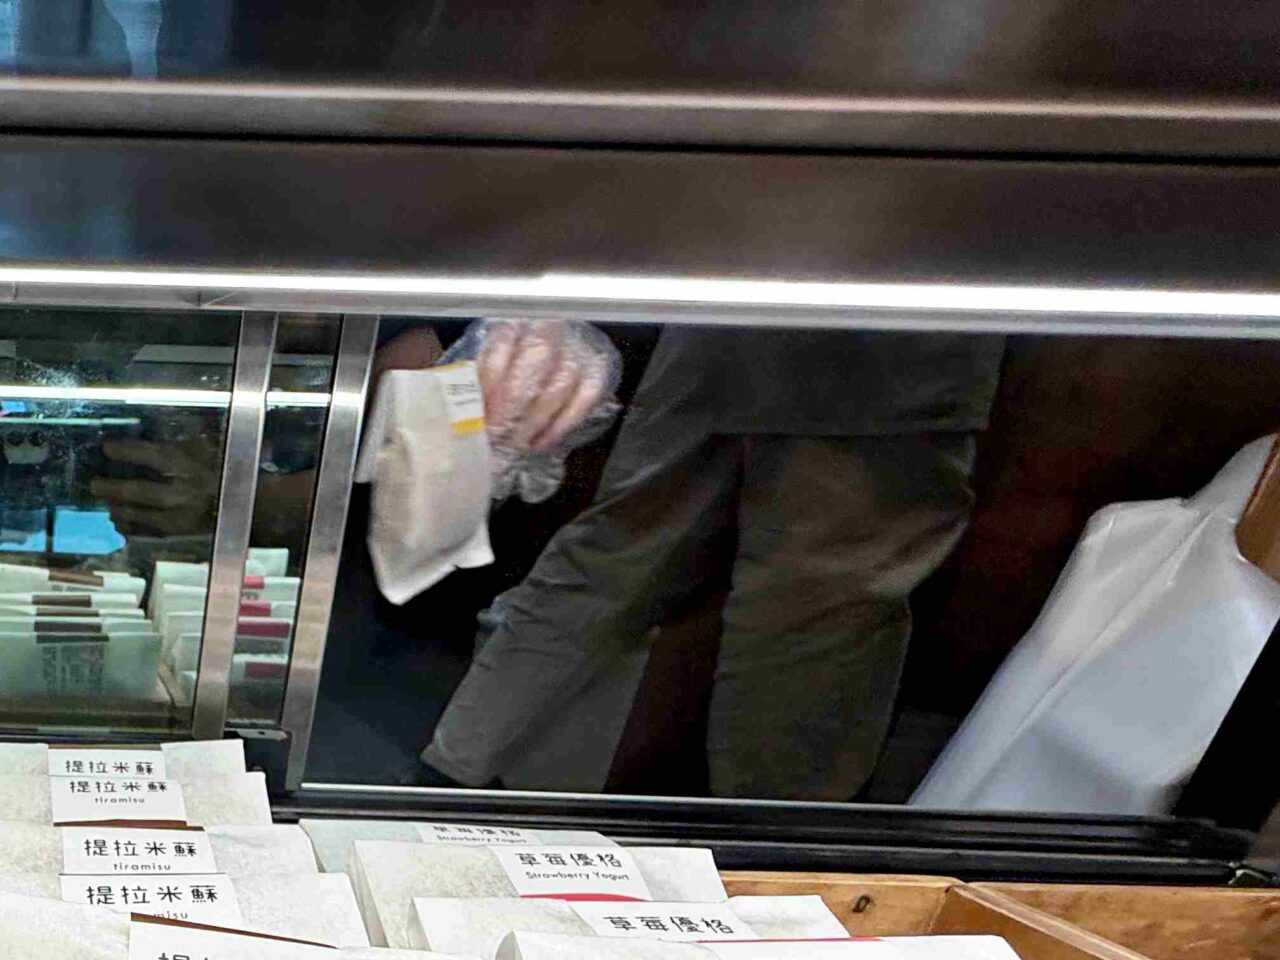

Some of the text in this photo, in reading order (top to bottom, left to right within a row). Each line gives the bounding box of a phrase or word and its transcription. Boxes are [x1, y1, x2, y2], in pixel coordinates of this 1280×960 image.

[65, 760, 154, 776] 提拉米蘇
[69, 781, 168, 793] 提拉米蘇
[84, 839, 198, 857] 提拉米蘇
[113, 862, 171, 871] tiramisu
[514, 852, 622, 868] 草莓優格
[525, 871, 630, 882] Strawberry Yogurt
[86, 885, 219, 906] 提拉米蘇
[604, 916, 734, 934] 草莓優格
